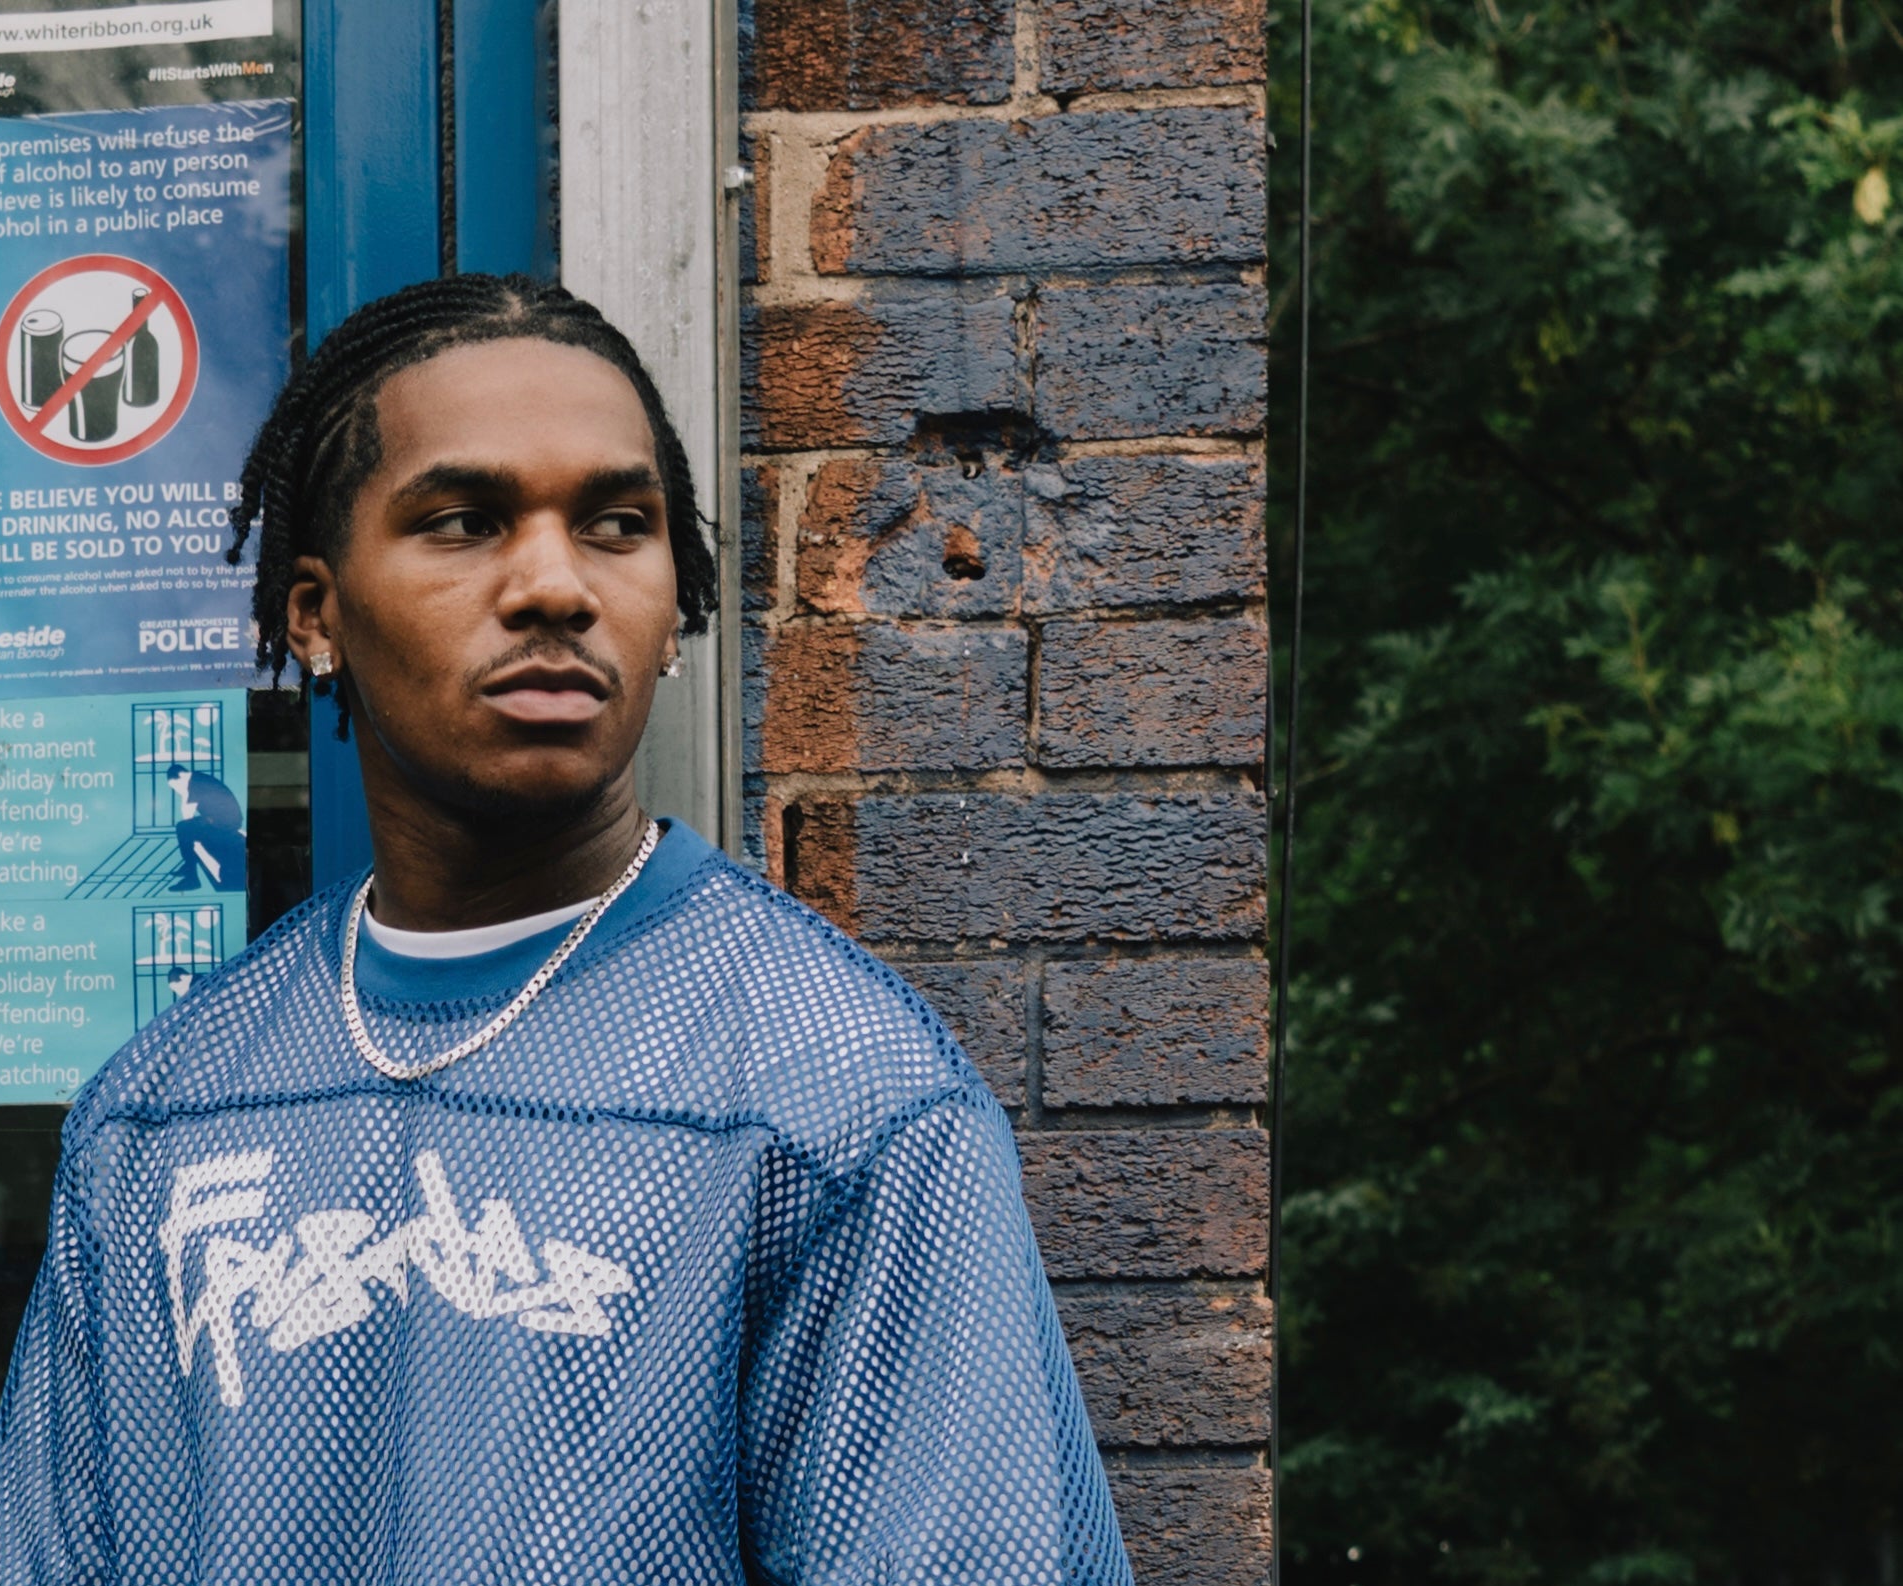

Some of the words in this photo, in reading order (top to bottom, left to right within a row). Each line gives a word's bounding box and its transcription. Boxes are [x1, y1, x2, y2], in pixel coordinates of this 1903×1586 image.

[148, 61, 274, 83] #ItStartsWithMen
[98, 129, 137, 151] will
[143, 125, 210, 148] refuse
[216, 122, 254, 143] the
[13, 158, 92, 183] alcohol
[99, 160, 122, 179] to
[129, 157, 167, 181] any
[174, 151, 248, 178] person
[49, 187, 64, 209] is
[71, 184, 128, 212] likely
[135, 182, 157, 202] to
[162, 178, 260, 203] consume
[48, 213, 68, 234] in
[75, 217, 88, 234] a
[95, 208, 160, 237] public
[166, 205, 223, 232] place
[10, 488, 97, 511] BELIEVE
[104, 485, 154, 506] YOU
[160, 482, 217, 503] WILL
[2, 512, 118, 538] DRINKING,
[126, 509, 160, 531] NO
[31, 542, 58, 562] BE
[65, 537, 125, 561] SOLD
[132, 536, 163, 557] TO
[170, 534, 221, 555] YOU
[4, 575, 15, 585] to
[17, 573, 62, 584] consume
[64, 570, 102, 581] alcohol
[104, 569, 132, 580] when
[134, 566, 164, 578] asked
[166, 566, 184, 577] not
[187, 566, 198, 576] to
[200, 564, 213, 578] by
[216, 563, 233, 575] the
[236, 563, 256, 577] poli
[40, 585, 57, 596] the
[59, 584, 97, 595] alcohol
[99, 581, 127, 593] when
[130, 579, 159, 591] asked
[161, 579, 173, 589] to
[175, 578, 189, 589] do
[192, 579, 203, 588] so
[205, 577, 218, 591] by
[221, 577, 239, 588] the
[139, 620, 178, 630] GREATER
[180, 617, 239, 628] MANCHESTER
[139, 626, 240, 654] POLICE
[17, 647, 65, 661] Borough
[32, 711, 44, 728] a
[62, 766, 114, 789] from
[33, 915, 46, 932] a
[64, 969, 115, 992] from
